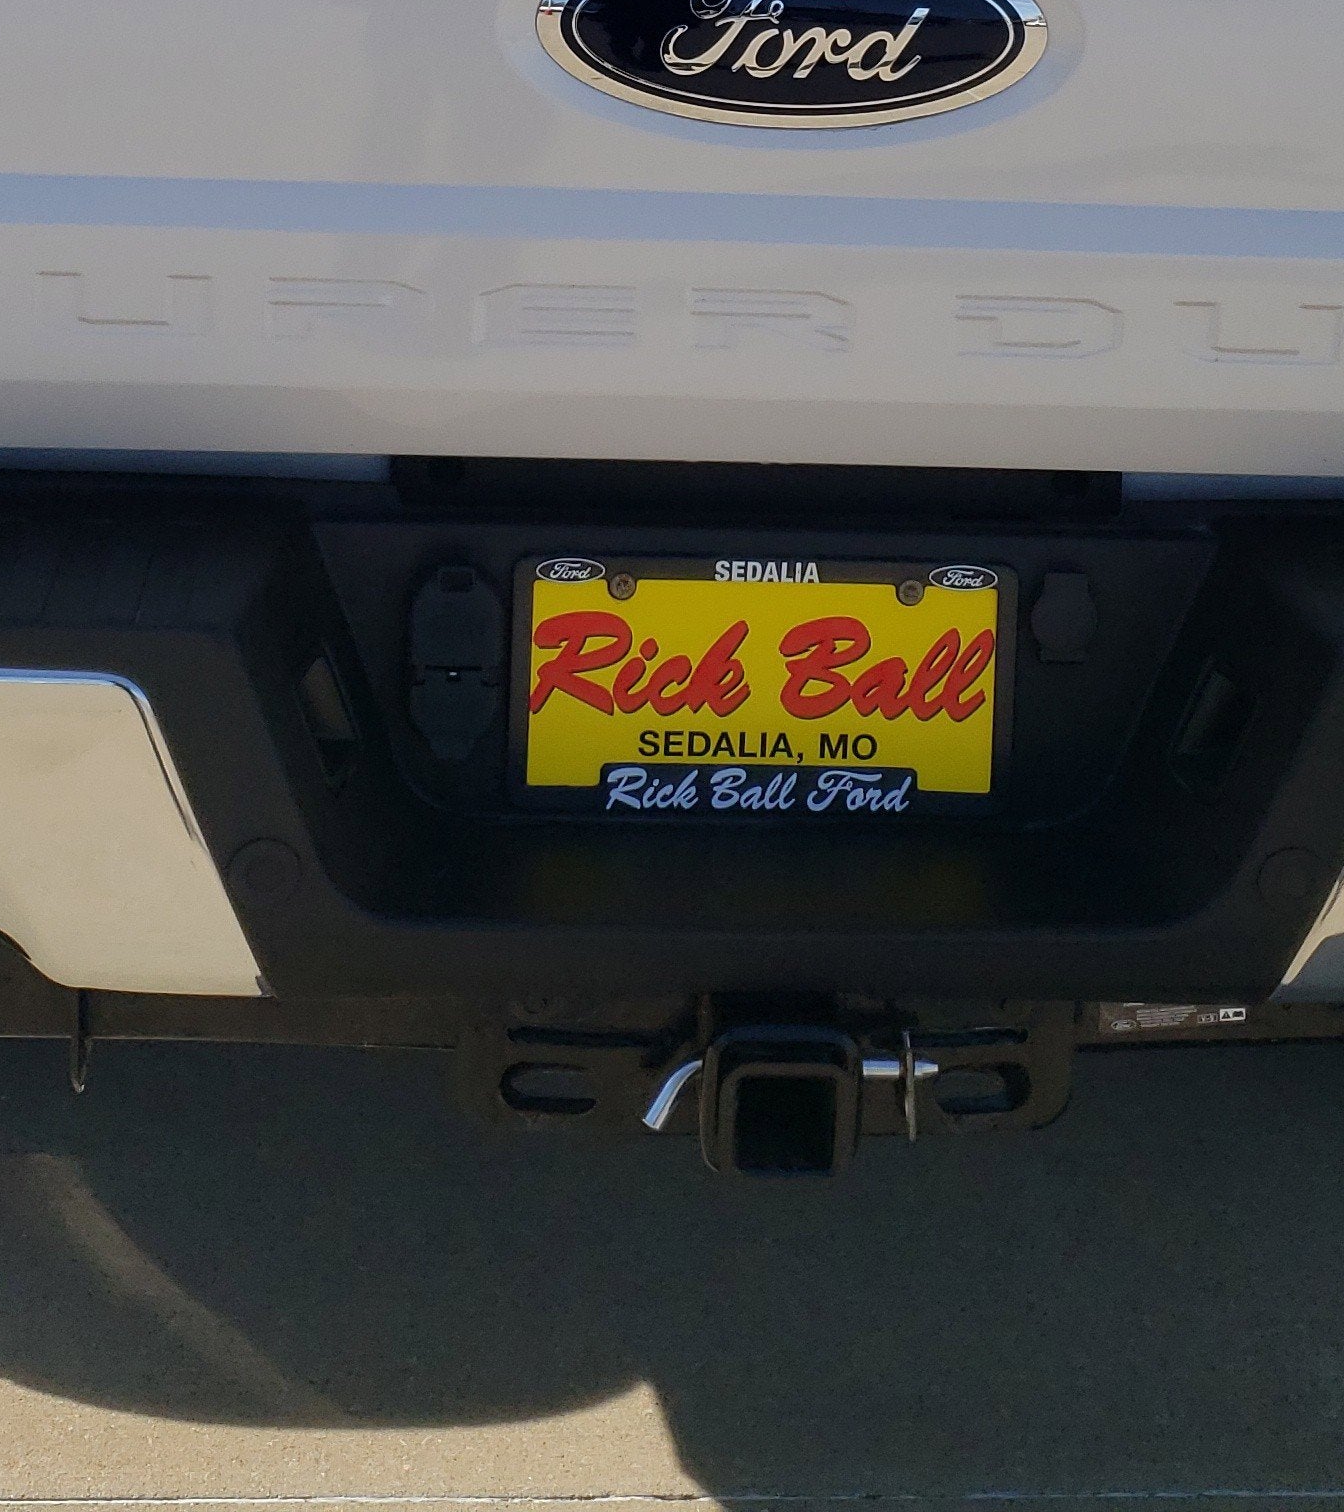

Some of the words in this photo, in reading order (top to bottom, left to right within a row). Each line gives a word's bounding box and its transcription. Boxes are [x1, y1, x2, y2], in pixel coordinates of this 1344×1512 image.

[549, 561, 591, 580] Ford
[714, 560, 820, 584] SEDALIA
[941, 568, 983, 588] Ford
[530, 611, 751, 717] Rick
[779, 615, 995, 722] Ball
[638, 730, 805, 764] SEDALIA,
[819, 733, 878, 760] MO
[606, 767, 699, 811] Rick
[709, 767, 796, 812] Ball
[807, 770, 910, 813] Ford
